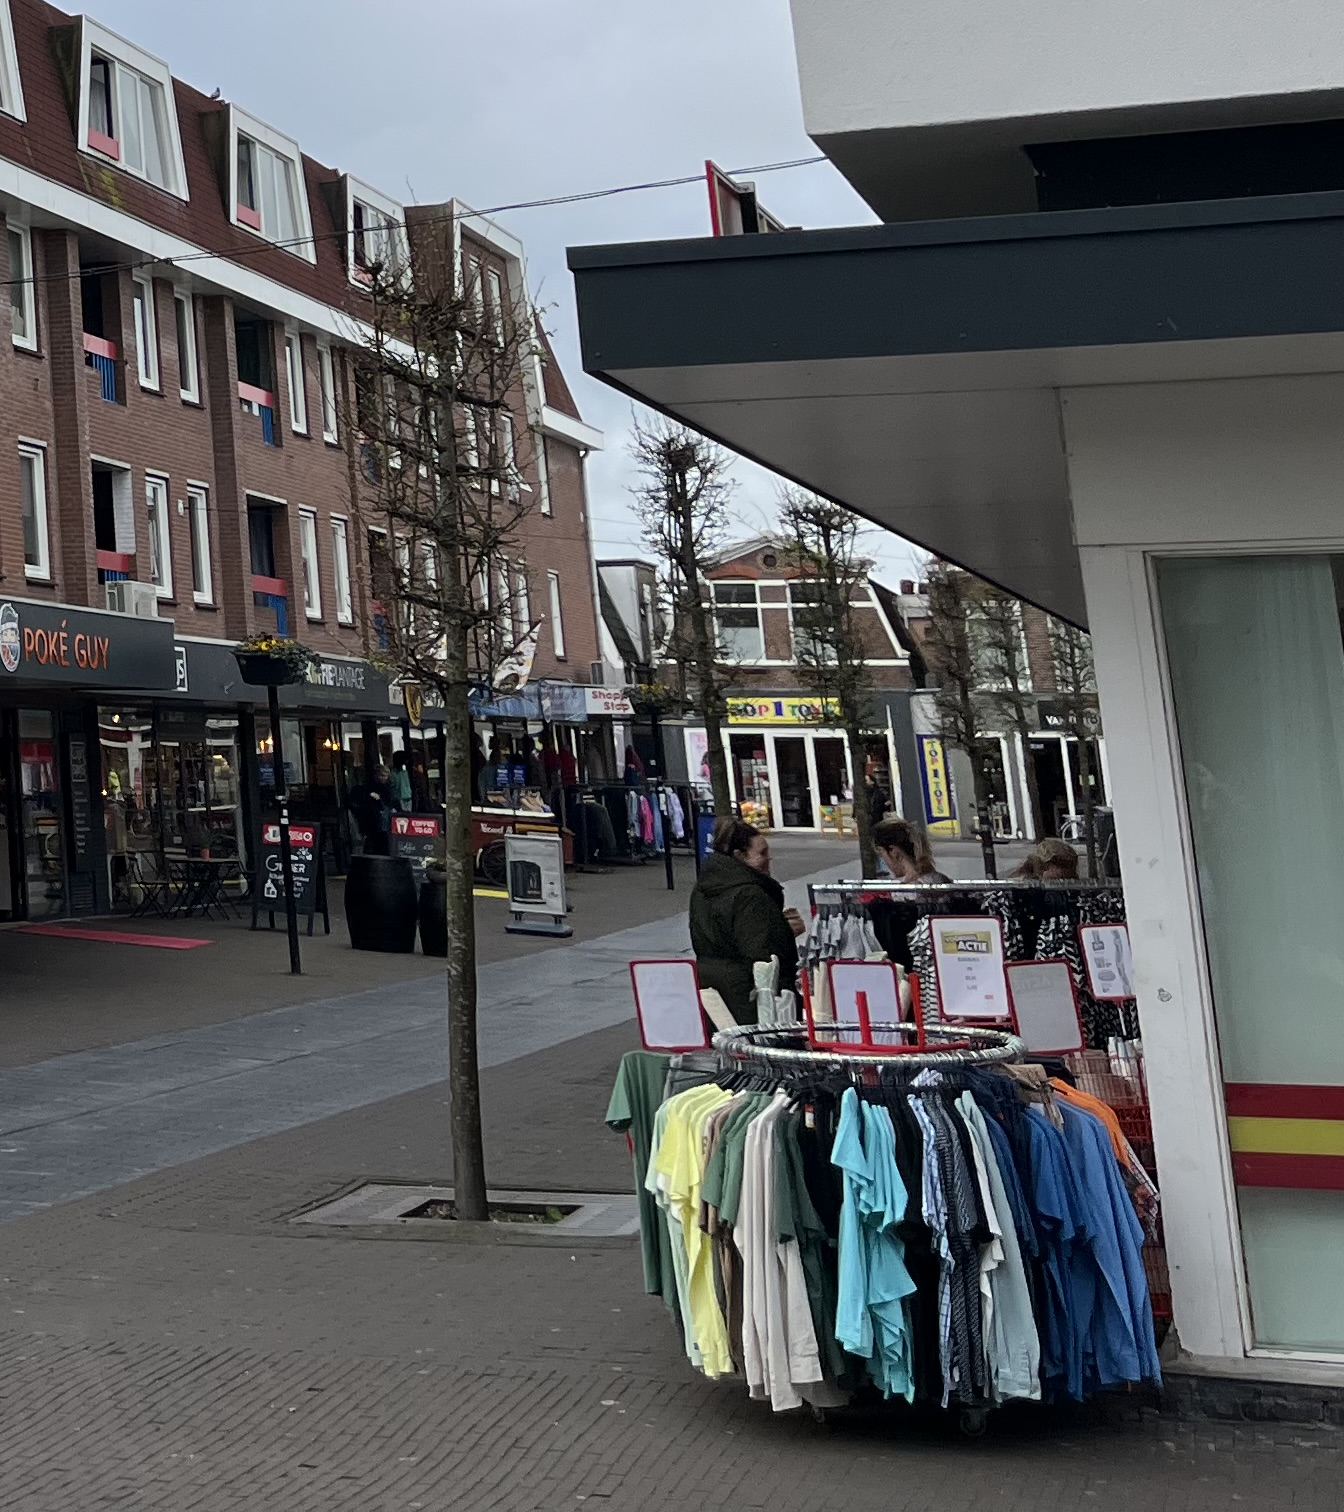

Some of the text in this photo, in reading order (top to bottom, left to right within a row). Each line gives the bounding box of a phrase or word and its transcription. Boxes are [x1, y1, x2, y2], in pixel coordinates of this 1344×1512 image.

[24, 620, 109, 670] POKÉ GUY
[604, 701, 629, 713] Stop
[958, 941, 988, 952] ACTIE
